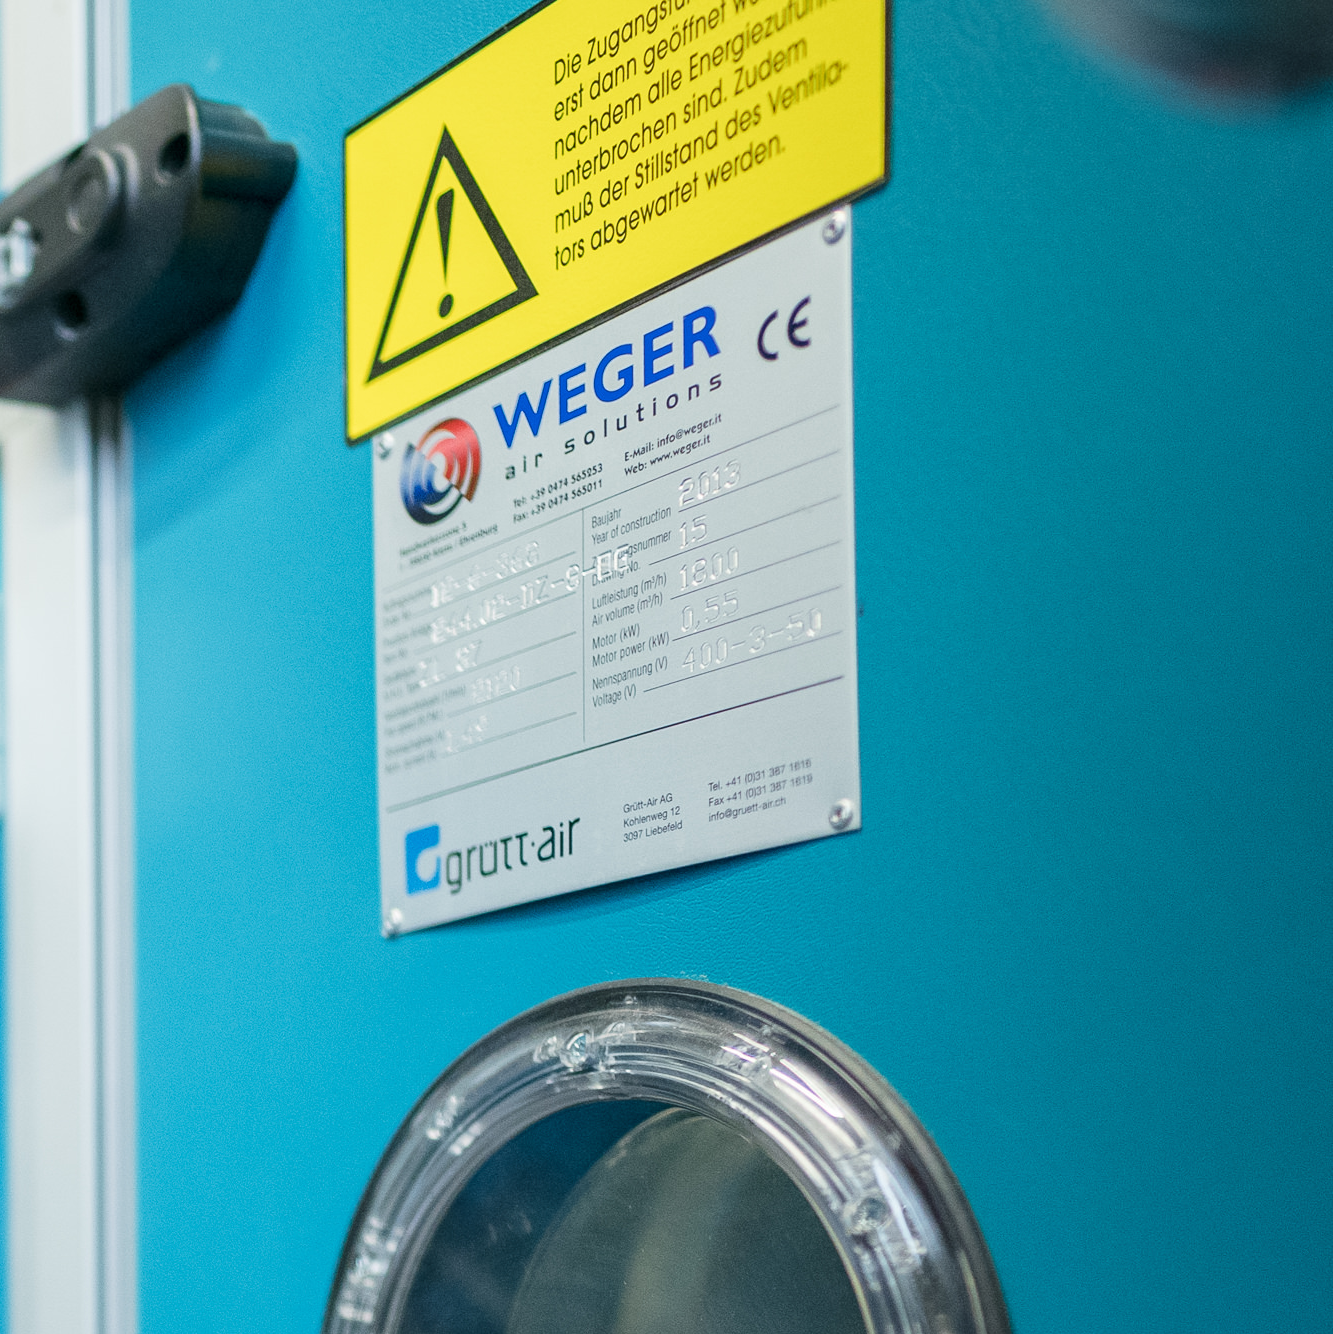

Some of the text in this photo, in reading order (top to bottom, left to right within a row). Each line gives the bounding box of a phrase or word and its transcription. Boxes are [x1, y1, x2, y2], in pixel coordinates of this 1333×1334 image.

[554, 0, 726, 121] erst dann geöffnet
[555, 53, 581, 85] Die
[555, 93, 641, 159] nachdem
[648, 69, 682, 104] alle
[555, 37, 808, 195] unterbrochen sind. Zudem
[555, 60, 850, 233] muß der Stillstand des Ventila-
[555, 134, 786, 270] tors abgewartet werden.
[492, 305, 721, 449] WEGER
[505, 373, 723, 480] air solutions
[624, 413, 722, 461] E-Mail: info@weger.it
[624, 434, 711, 476] Web: www.weger.it
[571, 479, 603, 499] 565011
[678, 458, 741, 507] 2013
[591, 508, 622, 529] Baujahr
[591, 506, 671, 545] Year of construction
[591, 583, 639, 610] Luftleistung
[591, 613, 603, 628] Air
[605, 603, 635, 622] volume
[592, 623, 640, 650] Motor (kW)
[592, 631, 670, 668] Motor power (kW)
[592, 656, 668, 691] Nennspannung (V)
[592, 683, 637, 708] Voltage (V)
[708, 780, 723, 792] Tel.
[725, 775, 741, 787] +41
[744, 769, 766, 785] (0)31
[708, 797, 724, 808] Fax
[726, 790, 742, 802] +41
[745, 784, 767, 801] (0)31
[623, 793, 673, 814] Grütt-Air AG
[623, 806, 681, 828] Kohlenweg 12
[708, 796, 787, 822] info@gruett-air.ch
[623, 820, 683, 843] 3097 Liebefeld
